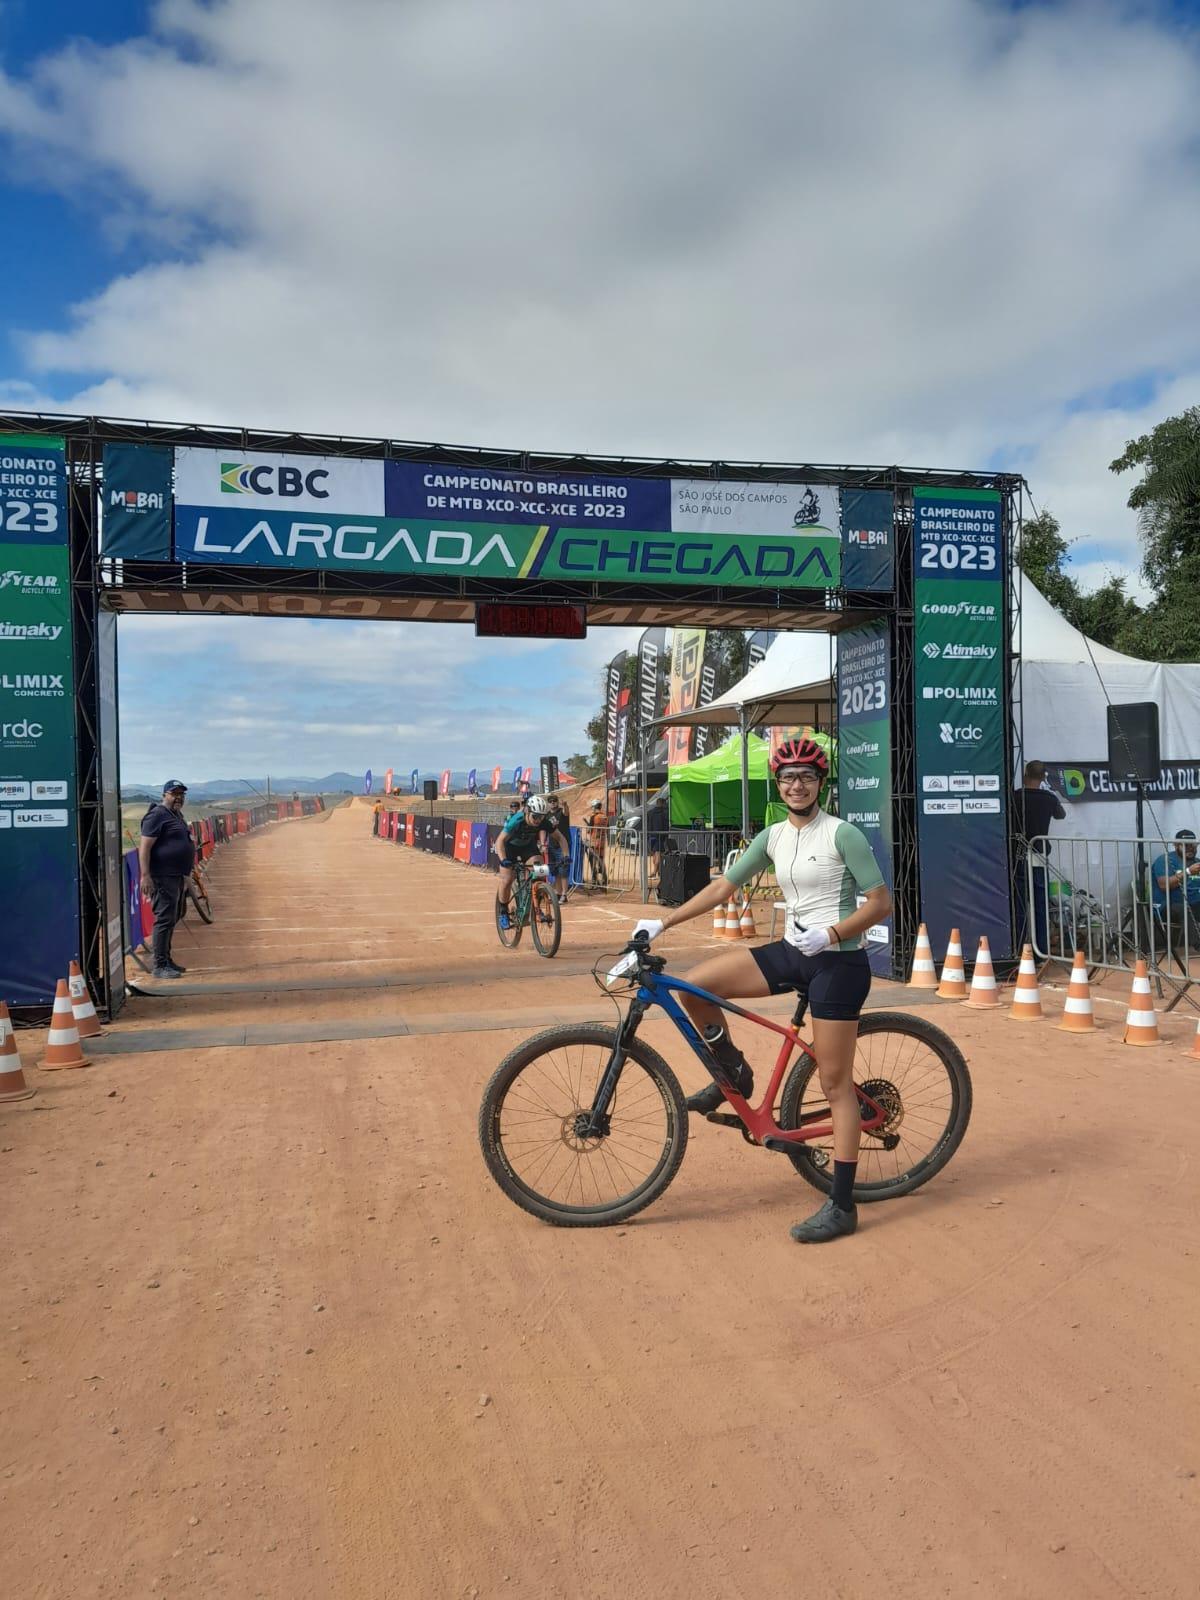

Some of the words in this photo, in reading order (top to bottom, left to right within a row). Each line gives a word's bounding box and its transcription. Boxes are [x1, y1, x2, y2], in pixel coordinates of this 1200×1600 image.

[0, 457, 57, 472] ONATO
[38, 475, 57, 486] DE
[250, 465, 330, 499] CBC
[423, 474, 534, 494] CAMPEONATO
[537, 482, 628, 499] BRASILEIRO
[0, 488, 58, 499] -XCC-XCE
[679, 490, 699, 500] SÃO
[725, 492, 745, 502] DOS
[747, 493, 788, 504] CAMPOS
[427, 495, 447, 508] DE
[449, 497, 483, 510] MTB
[486, 499, 577, 516] XCO-XCC-XCE
[584, 503, 626, 518] 2023
[679, 503, 699, 514] SÃO
[701, 505, 732, 515] PAULO
[920, 507, 995, 520] CAMPEONATO
[0, 501, 58, 533] 23
[921, 520, 980, 532] BRASILEIRO
[982, 523, 995, 532] DE
[193, 517, 517, 569] LARGADA
[921, 533, 940, 541] MTB
[942, 533, 995, 543] XCO-XCC-XCE
[558, 538, 832, 578] CHEGADA
[921, 543, 996, 571] 2023
[921, 602, 995, 616] GOODYEAR
[841, 638, 885, 662] CAMPEONATO
[942, 643, 997, 659] Atimaky
[842, 658, 876, 675] BRASILEIRO
[877, 653, 886, 664] DE
[0, 674, 64, 689] LIMIX
[842, 680, 886, 716] 2023
[934, 687, 997, 699] POLIMIX
[607, 668, 620, 765] SPECIALIZED
[2, 718, 44, 738] rdc
[954, 723, 983, 740] rdc
[1178, 768, 1200, 791] DIL
[22, 814, 42, 822] UCI
[852, 812, 880, 823] POLIMIX
